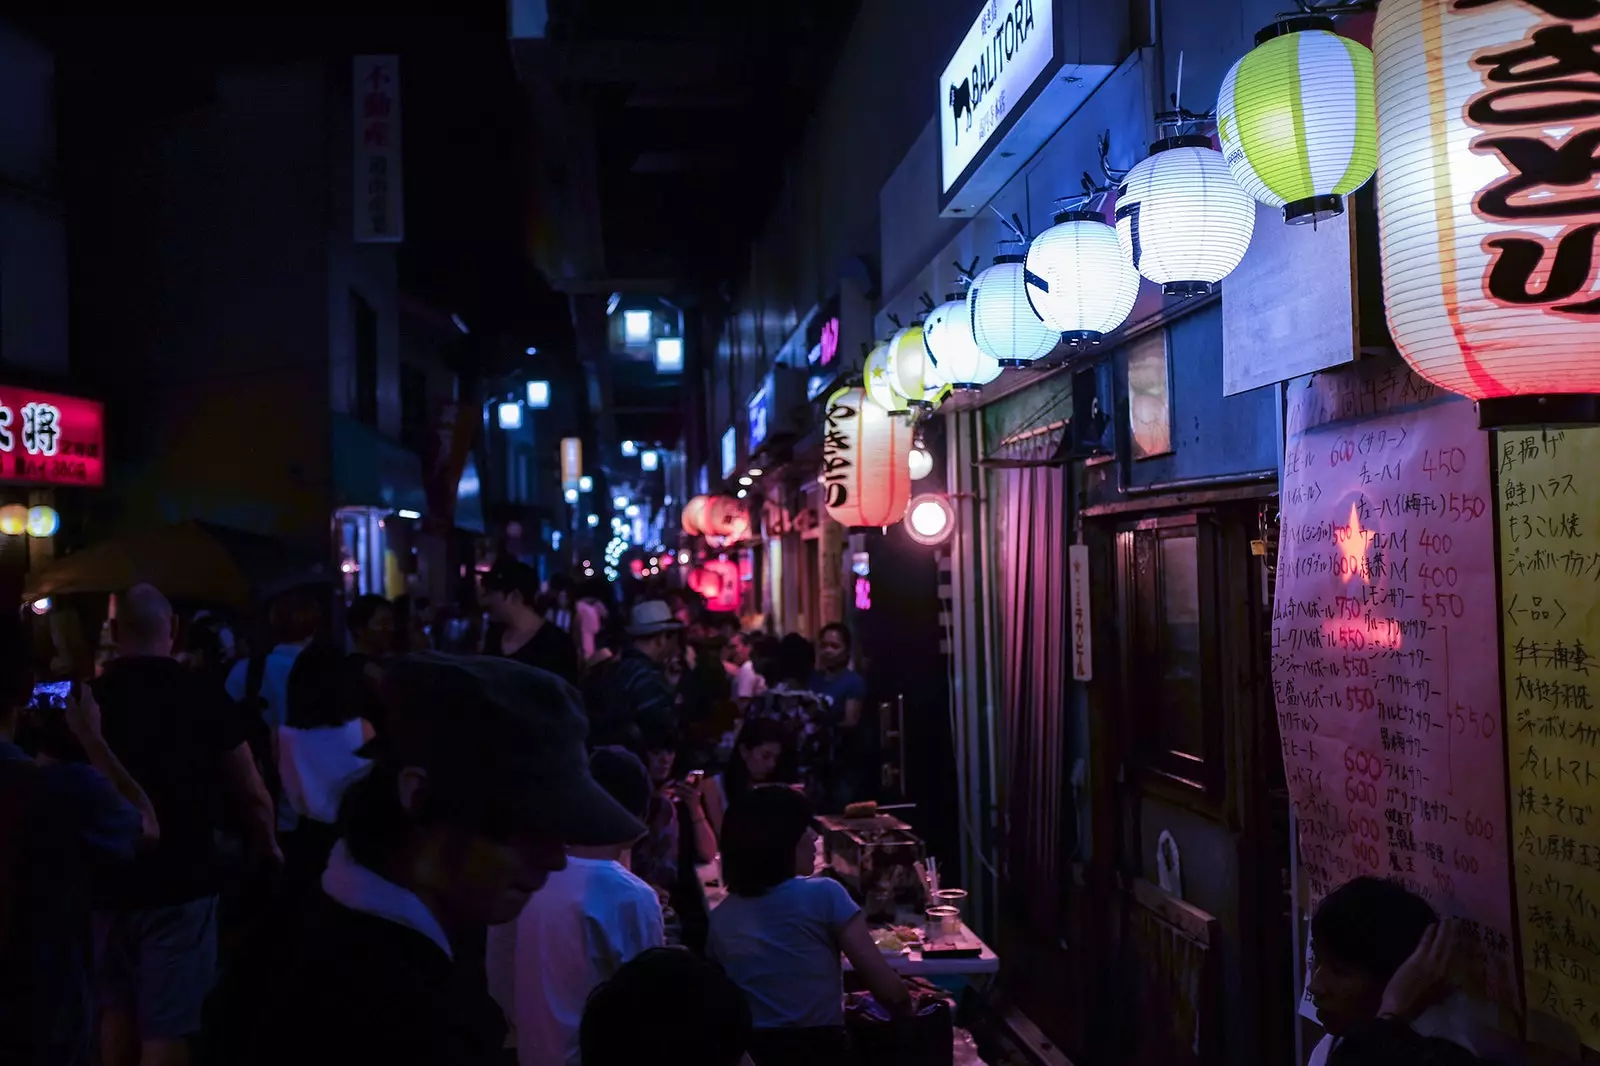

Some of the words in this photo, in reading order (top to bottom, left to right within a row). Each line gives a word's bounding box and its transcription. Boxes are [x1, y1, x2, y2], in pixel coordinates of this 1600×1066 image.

[971, 0, 1034, 111] BALITORA
[1331, 436, 1354, 467] 600
[1360, 459, 1402, 486] チューハイ
[1422, 448, 1466, 480] 450
[1500, 431, 1565, 475] 厚揚げ
[1449, 492, 1485, 522] 550
[1505, 474, 1577, 511] 鮭ハラス
[1332, 520, 1352, 547] 500
[1358, 525, 1408, 552] ウーロンハイ
[1419, 528, 1452, 554] 400
[1509, 512, 1583, 543] もろこし焼
[1332, 552, 1357, 577] 600
[1360, 552, 1408, 582] 緑茶ハイ
[1419, 563, 1457, 589] 400
[1336, 596, 1361, 619] 750
[1362, 585, 1414, 608] レモンサワー
[1422, 593, 1464, 618] 550
[1339, 627, 1365, 652] 550
[1343, 655, 1369, 678] 550
[1346, 685, 1375, 712] 550
[1453, 701, 1495, 739] 550
[1344, 746, 1383, 781] 600
[1345, 776, 1377, 809] 600
[1517, 786, 1592, 825] 焼きそば
[1348, 809, 1379, 842] 600
[1465, 810, 1493, 840] 600
[1353, 841, 1379, 869] 600
[1454, 849, 1479, 874] 600
